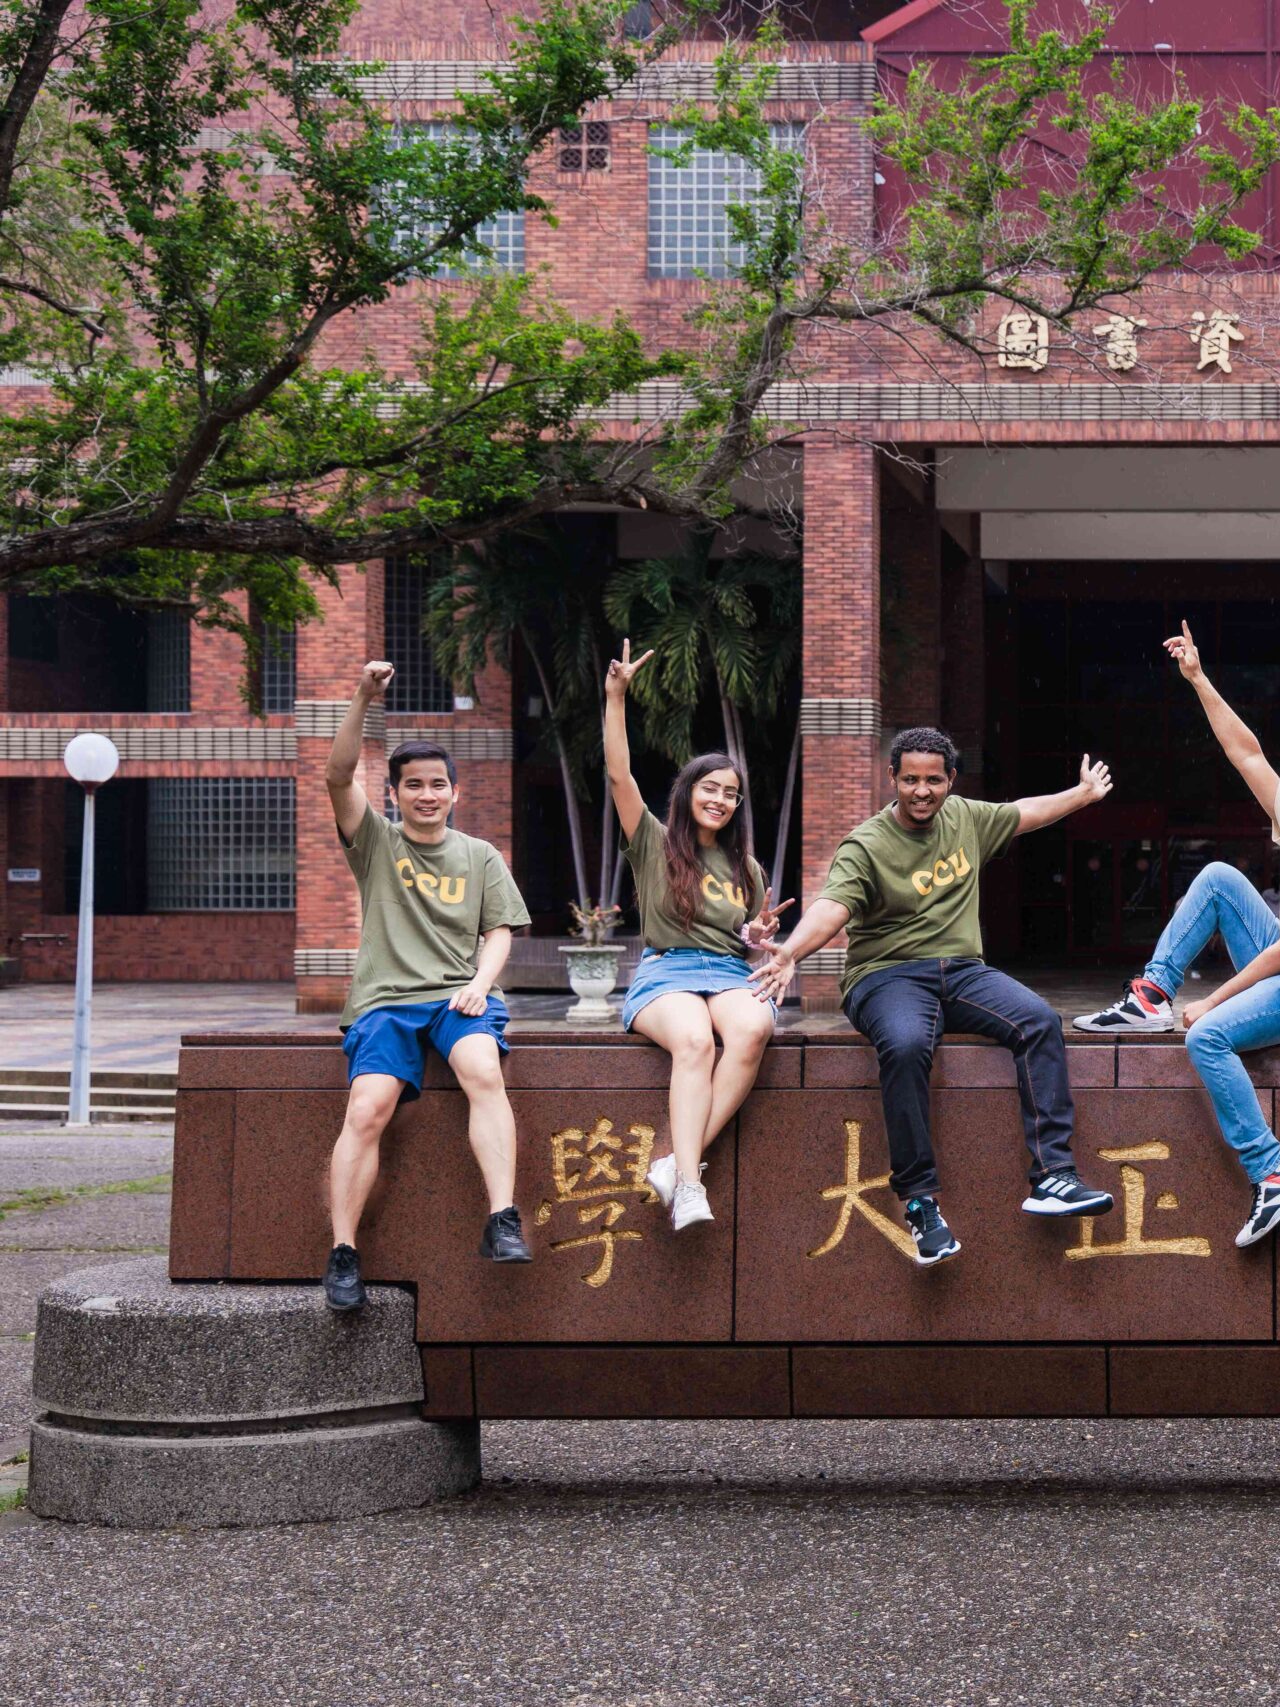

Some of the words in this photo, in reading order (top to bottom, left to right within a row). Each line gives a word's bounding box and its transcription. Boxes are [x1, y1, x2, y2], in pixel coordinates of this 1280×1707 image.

[395, 857, 466, 904] CCU
[702, 873, 746, 908] CU
[911, 846, 971, 896] CCU
